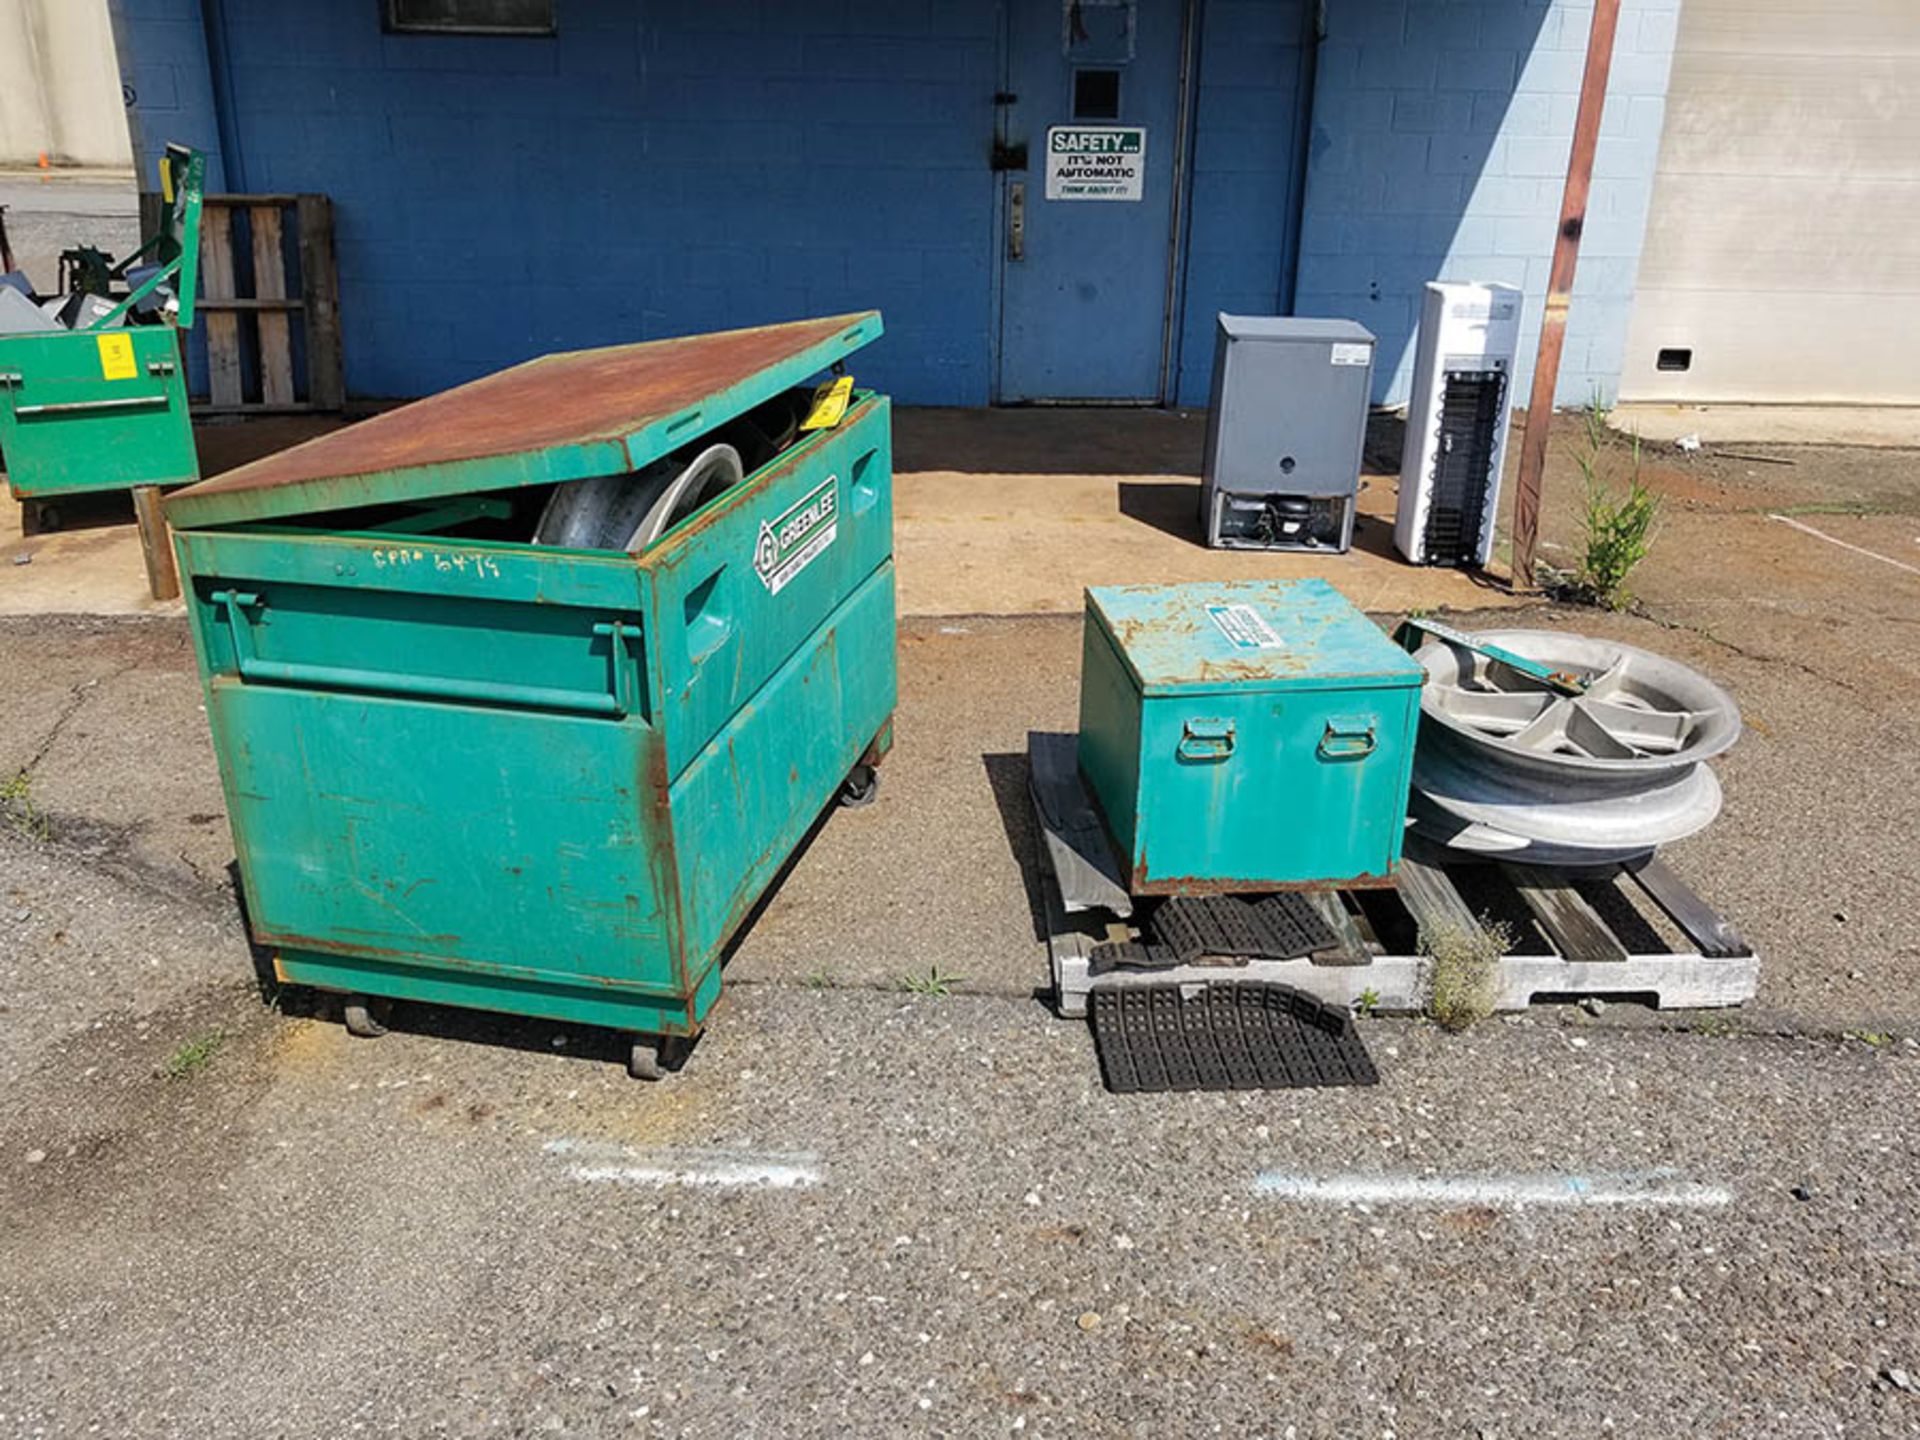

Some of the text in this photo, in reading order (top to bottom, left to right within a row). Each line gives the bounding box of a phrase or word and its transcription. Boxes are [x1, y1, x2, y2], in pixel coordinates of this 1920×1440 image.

[1055, 133, 1138, 151] SAFETY...
[1096, 155, 1124, 165] NOT
[1057, 168, 1135, 178] AUTOMATIC
